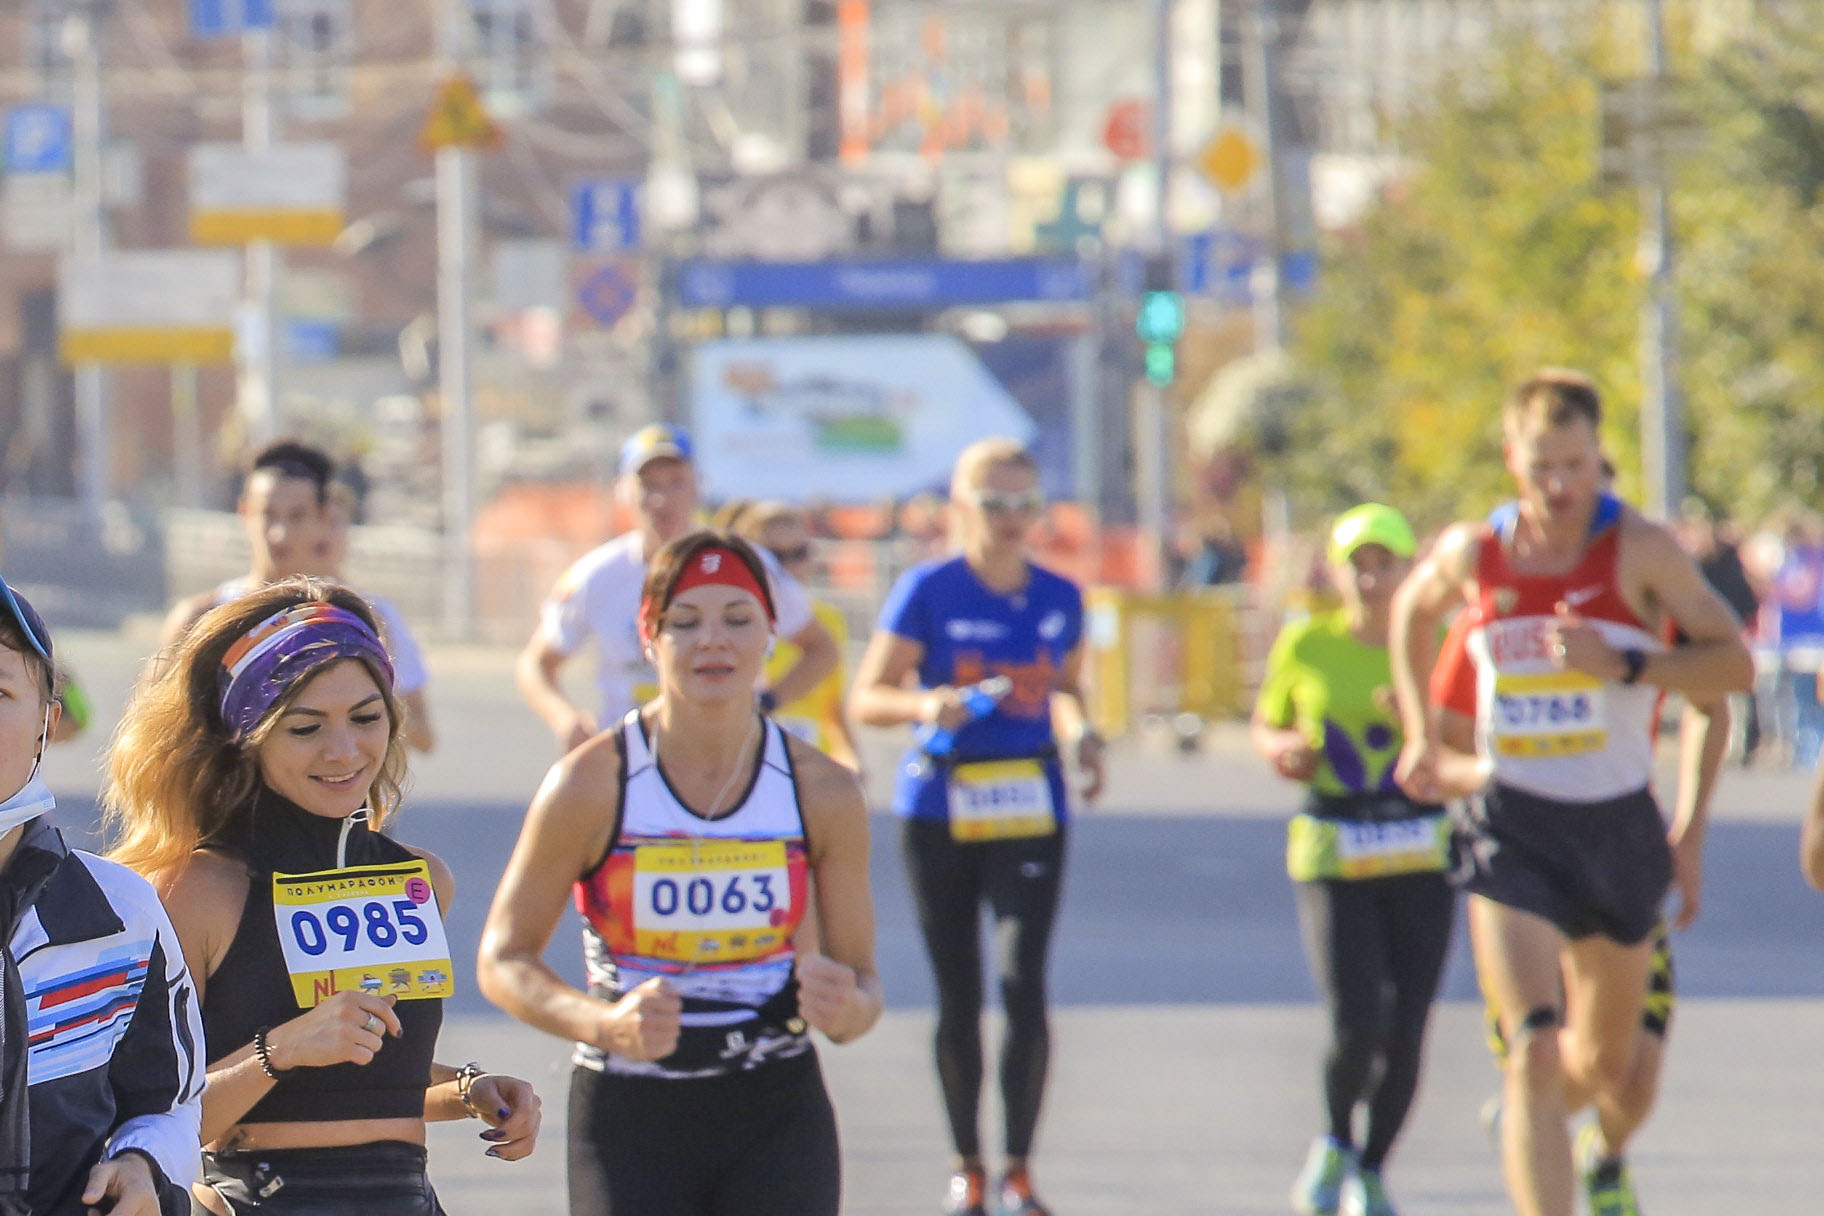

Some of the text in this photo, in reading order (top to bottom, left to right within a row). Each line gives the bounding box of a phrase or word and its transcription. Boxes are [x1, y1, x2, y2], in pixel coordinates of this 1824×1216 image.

[286, 876, 396, 897] ПОЛУМАРАФОН
[651, 874, 775, 916] 0063
[291, 900, 428, 956] 0985
